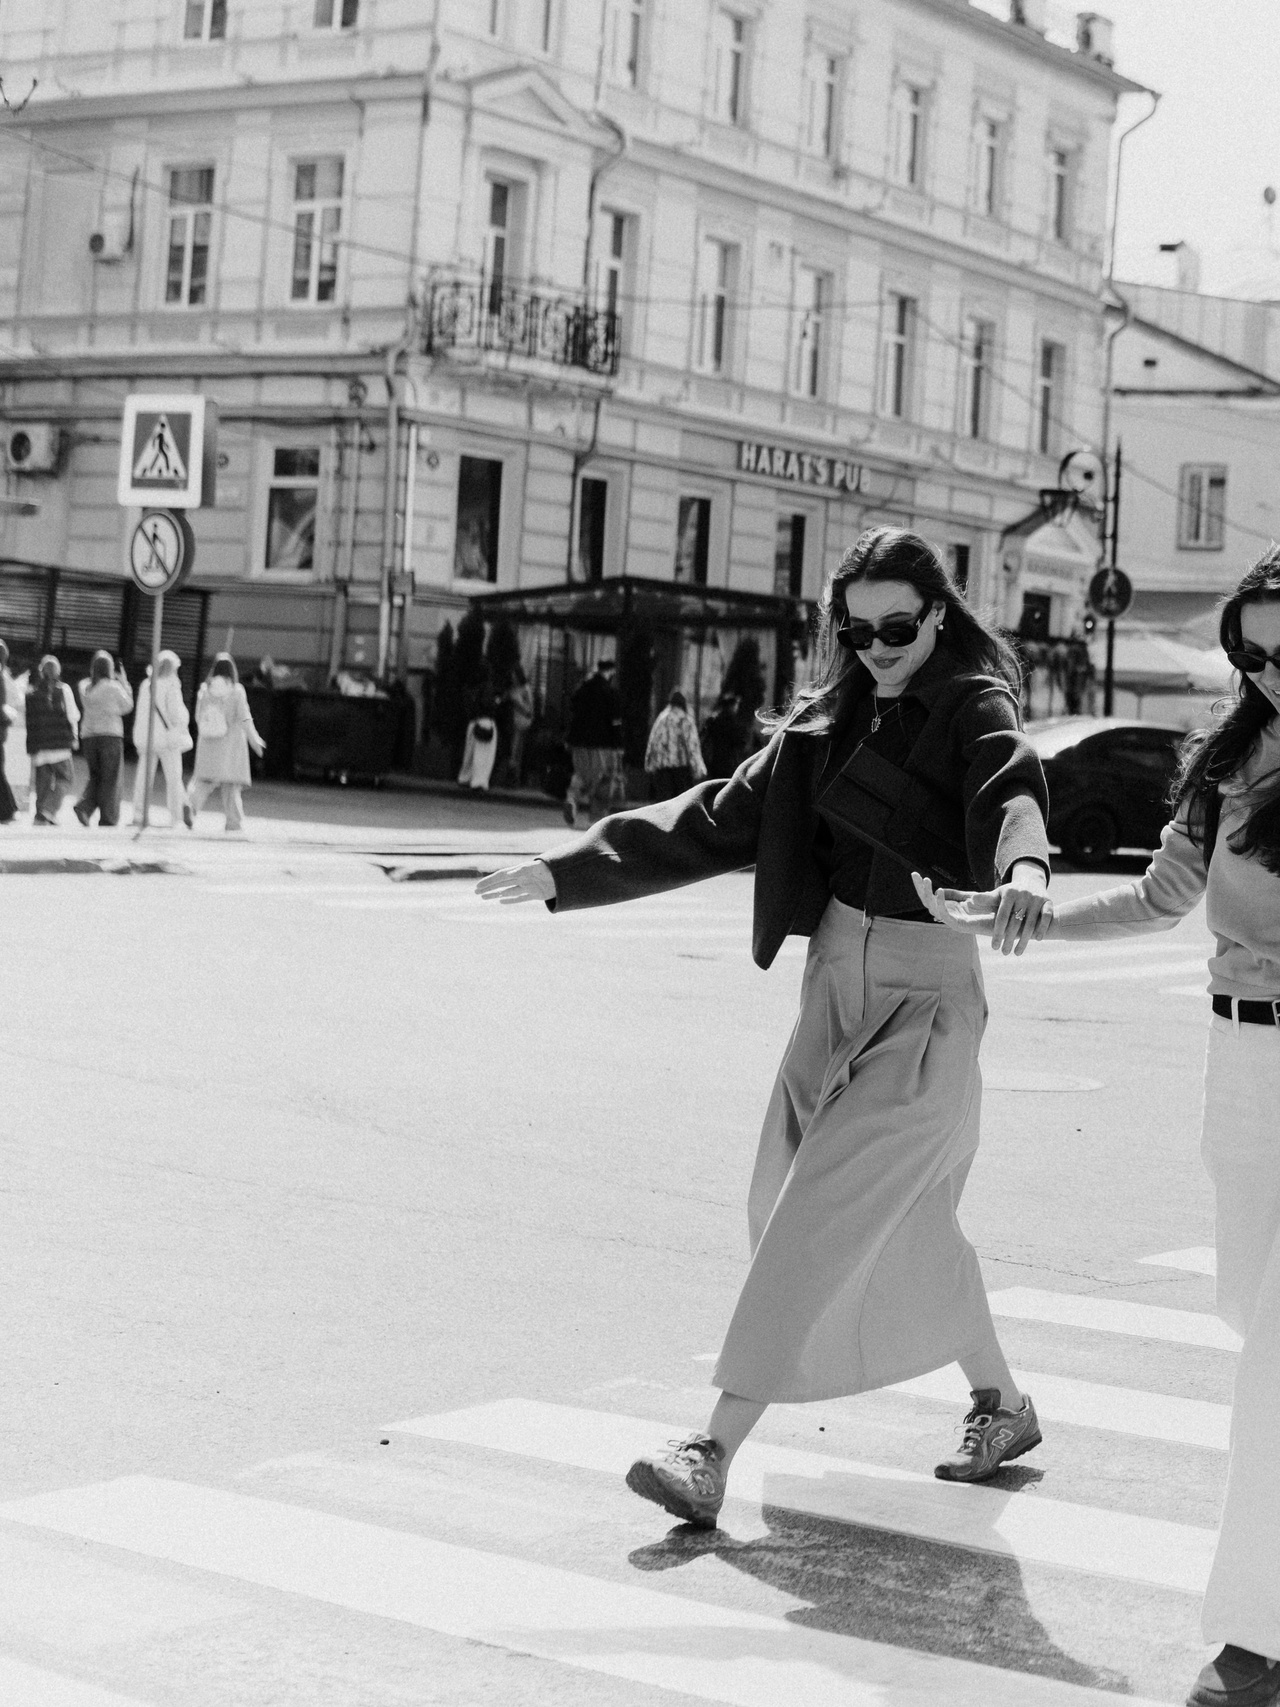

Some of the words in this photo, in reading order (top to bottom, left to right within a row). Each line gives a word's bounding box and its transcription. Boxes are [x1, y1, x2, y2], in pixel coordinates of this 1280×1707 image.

[741, 442, 829, 486] HARAT'S
[833, 460, 871, 493] PUB
[991, 1428, 1014, 1450] N
